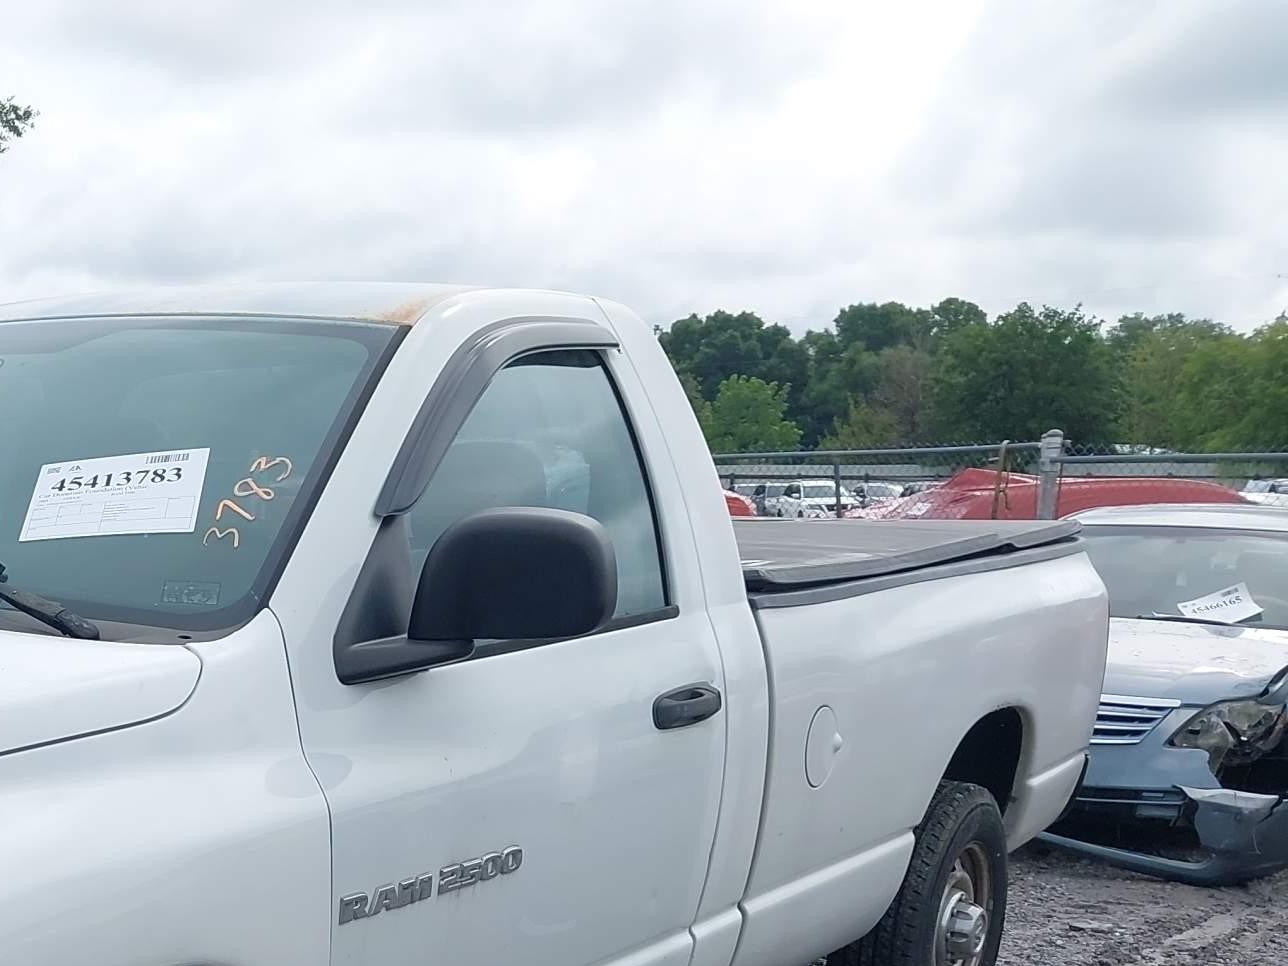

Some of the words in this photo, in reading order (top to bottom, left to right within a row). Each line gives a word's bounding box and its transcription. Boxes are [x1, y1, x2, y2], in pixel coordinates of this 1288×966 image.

[51, 466, 183, 491] 45413783
[202, 456, 293, 548] 3783
[338, 872, 433, 925] RAM
[437, 844, 523, 896] 2500
